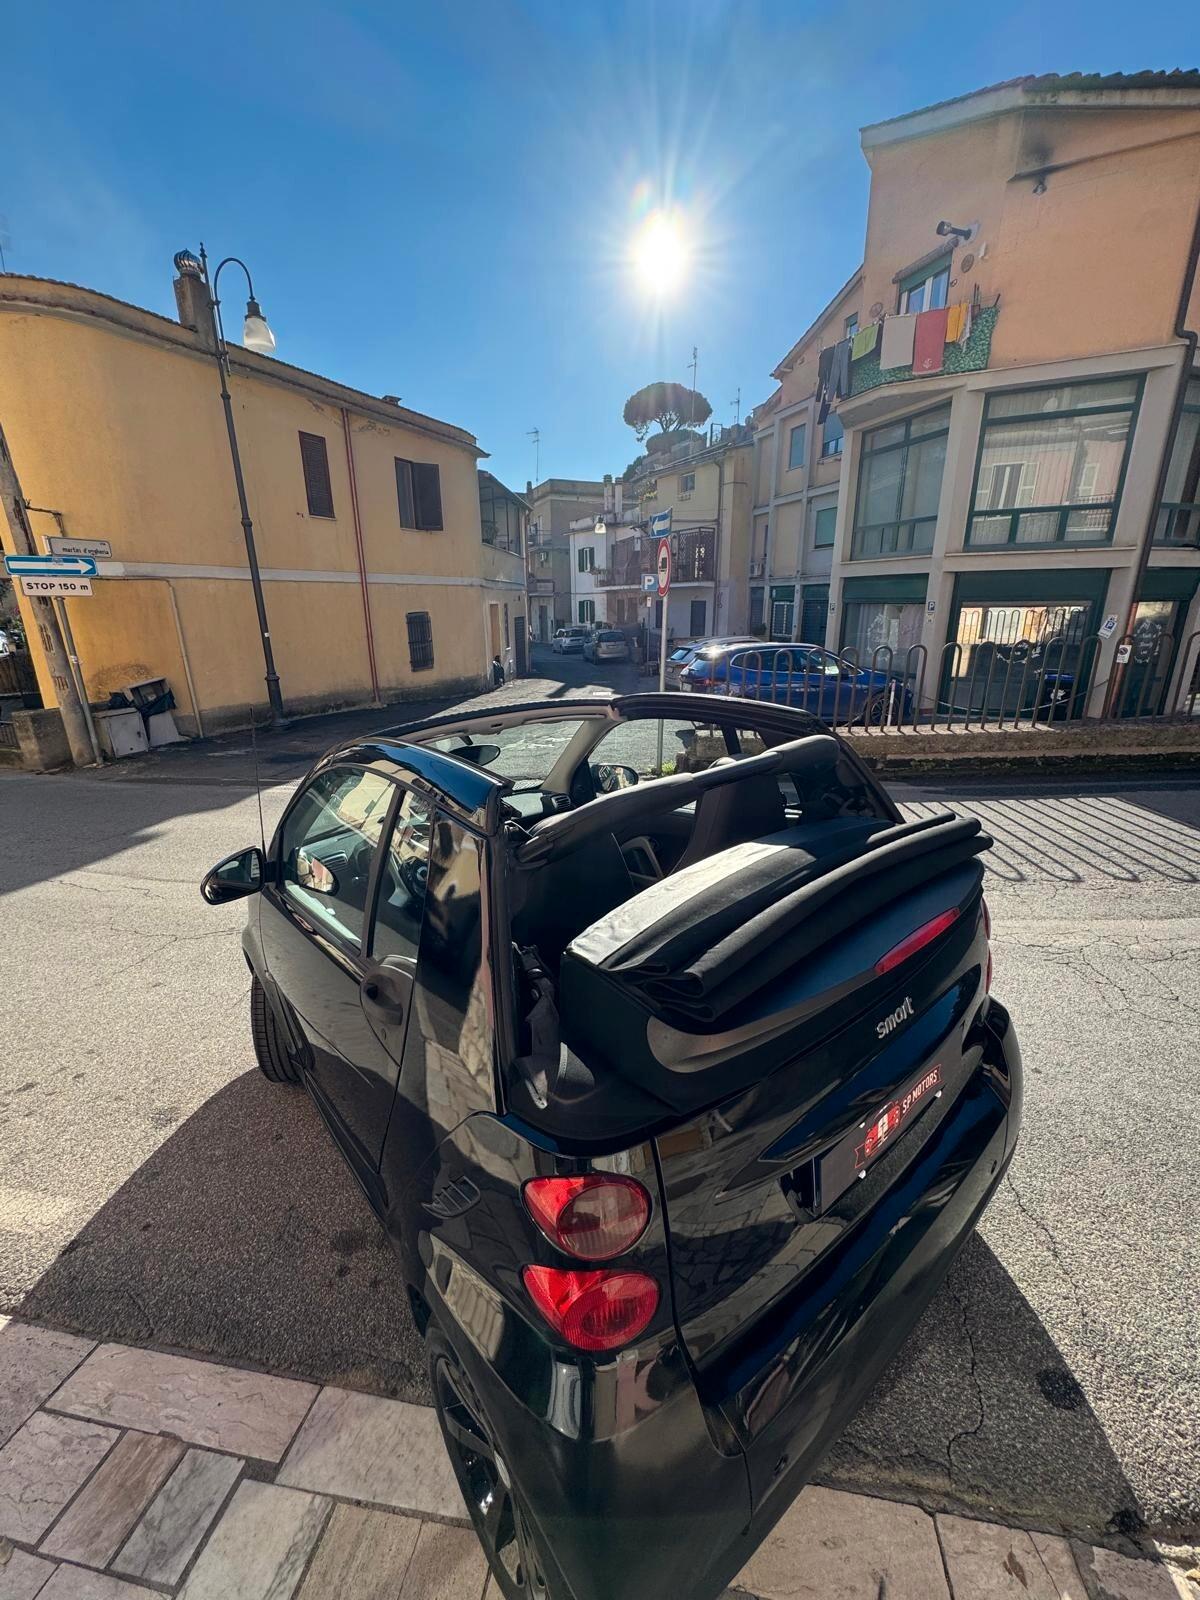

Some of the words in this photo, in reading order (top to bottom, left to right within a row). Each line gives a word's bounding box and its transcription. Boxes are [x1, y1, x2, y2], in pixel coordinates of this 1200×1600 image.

[26, 582, 56, 590] STOP
[644, 576, 655, 590] P
[876, 996, 914, 1039] smart
[912, 1069, 938, 1102] MOTORS
